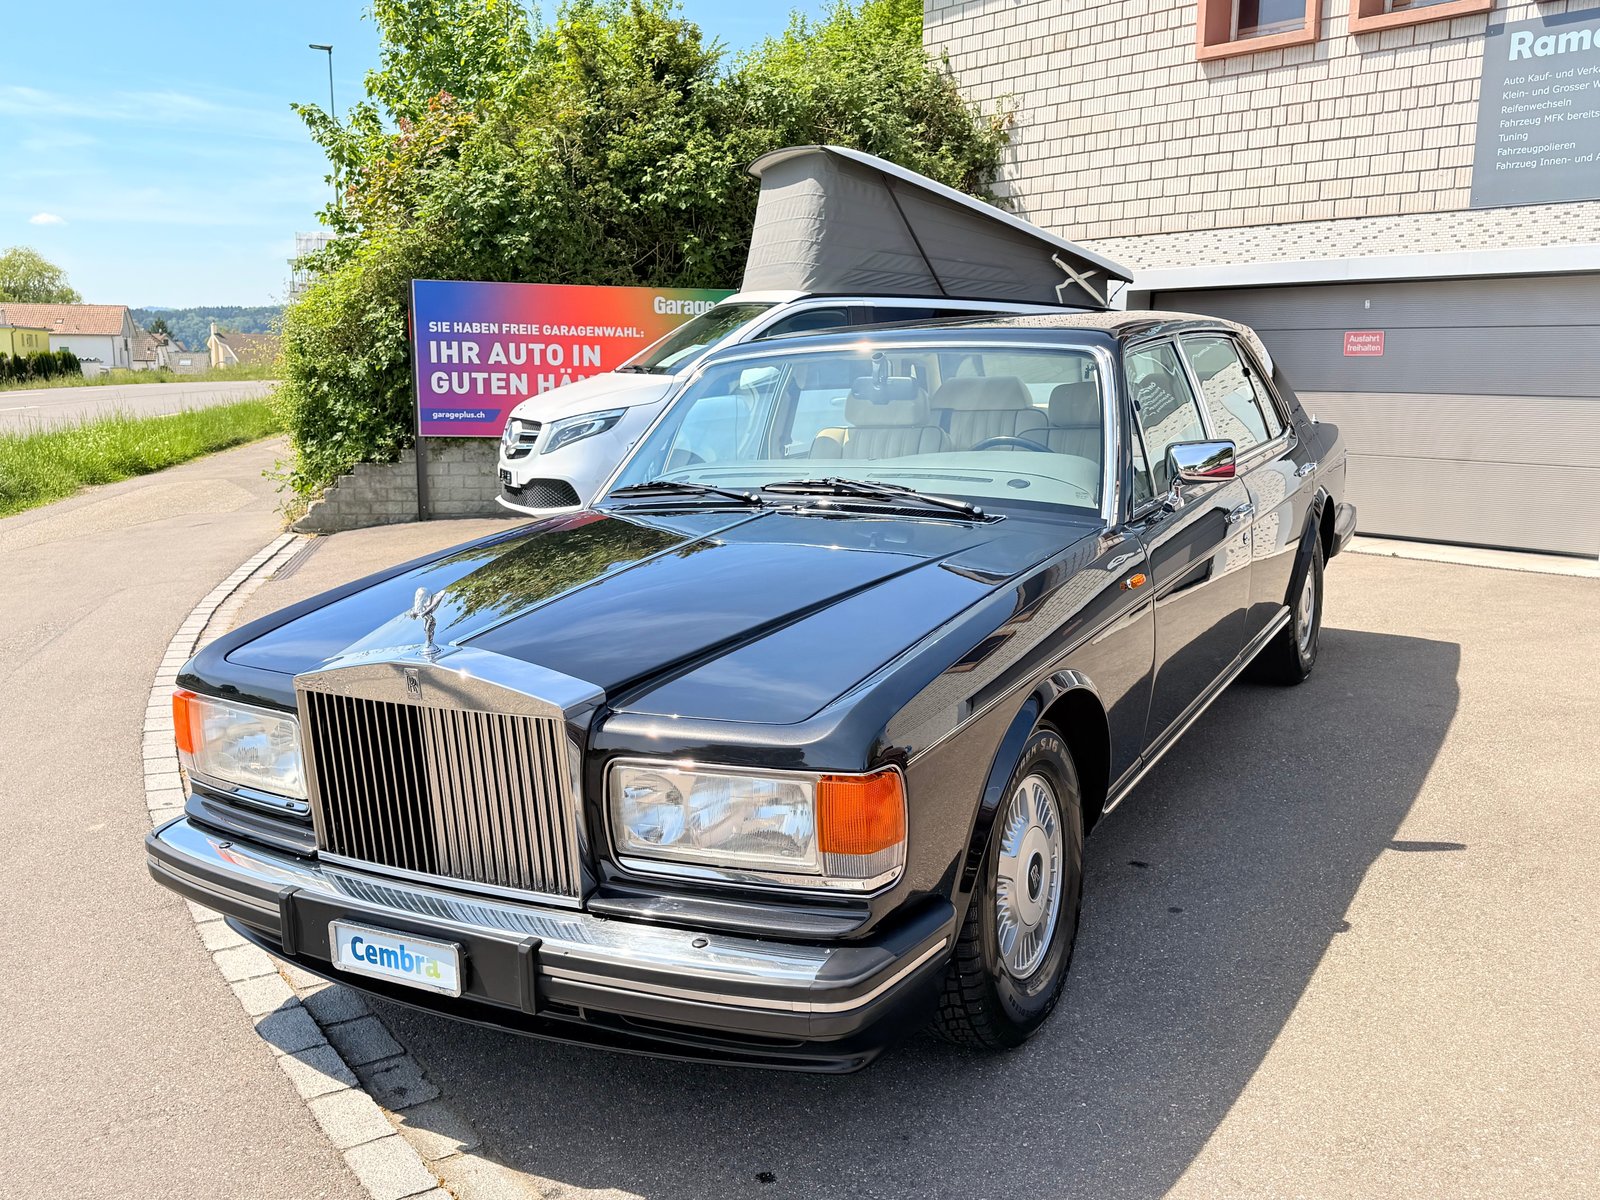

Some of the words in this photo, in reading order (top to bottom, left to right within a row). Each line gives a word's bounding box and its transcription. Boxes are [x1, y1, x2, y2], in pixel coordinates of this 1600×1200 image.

[1503, 77, 1525, 86] Auto
[1528, 71, 1553, 82] Kauf-
[1555, 68, 1574, 79] und
[1502, 90, 1529, 100] Klein-
[1532, 86, 1550, 96] und
[1552, 82, 1590, 94] Grosser
[1501, 98, 1572, 114] Reifenwechseln
[1500, 117, 1541, 128] Fahrzeug
[1544, 112, 1564, 123] MFK
[1567, 109, 1600, 121] bereits
[1498, 132, 1529, 142] Tuning
[1497, 141, 1576, 156] Fahrzeugpolieren
[1540, 157, 1572, 166] Innen-
[1574, 152, 1593, 163] und
[653, 296, 716, 316] Garage
[428, 321, 451, 333] SIE
[453, 322, 499, 334] HABEN
[502, 323, 540, 335] FREIE
[542, 324, 645, 338] GARAGENWAHL:
[1349, 334, 1380, 343] Ausfahrt
[429, 340, 481, 364] IHR
[487, 342, 564, 366] AUTO
[572, 344, 601, 367] IN
[1346, 343, 1381, 352] freihalten
[430, 371, 528, 395] GUTEN
[432, 411, 486, 420] garageplus.ch
[350, 935, 441, 979] Cembra
